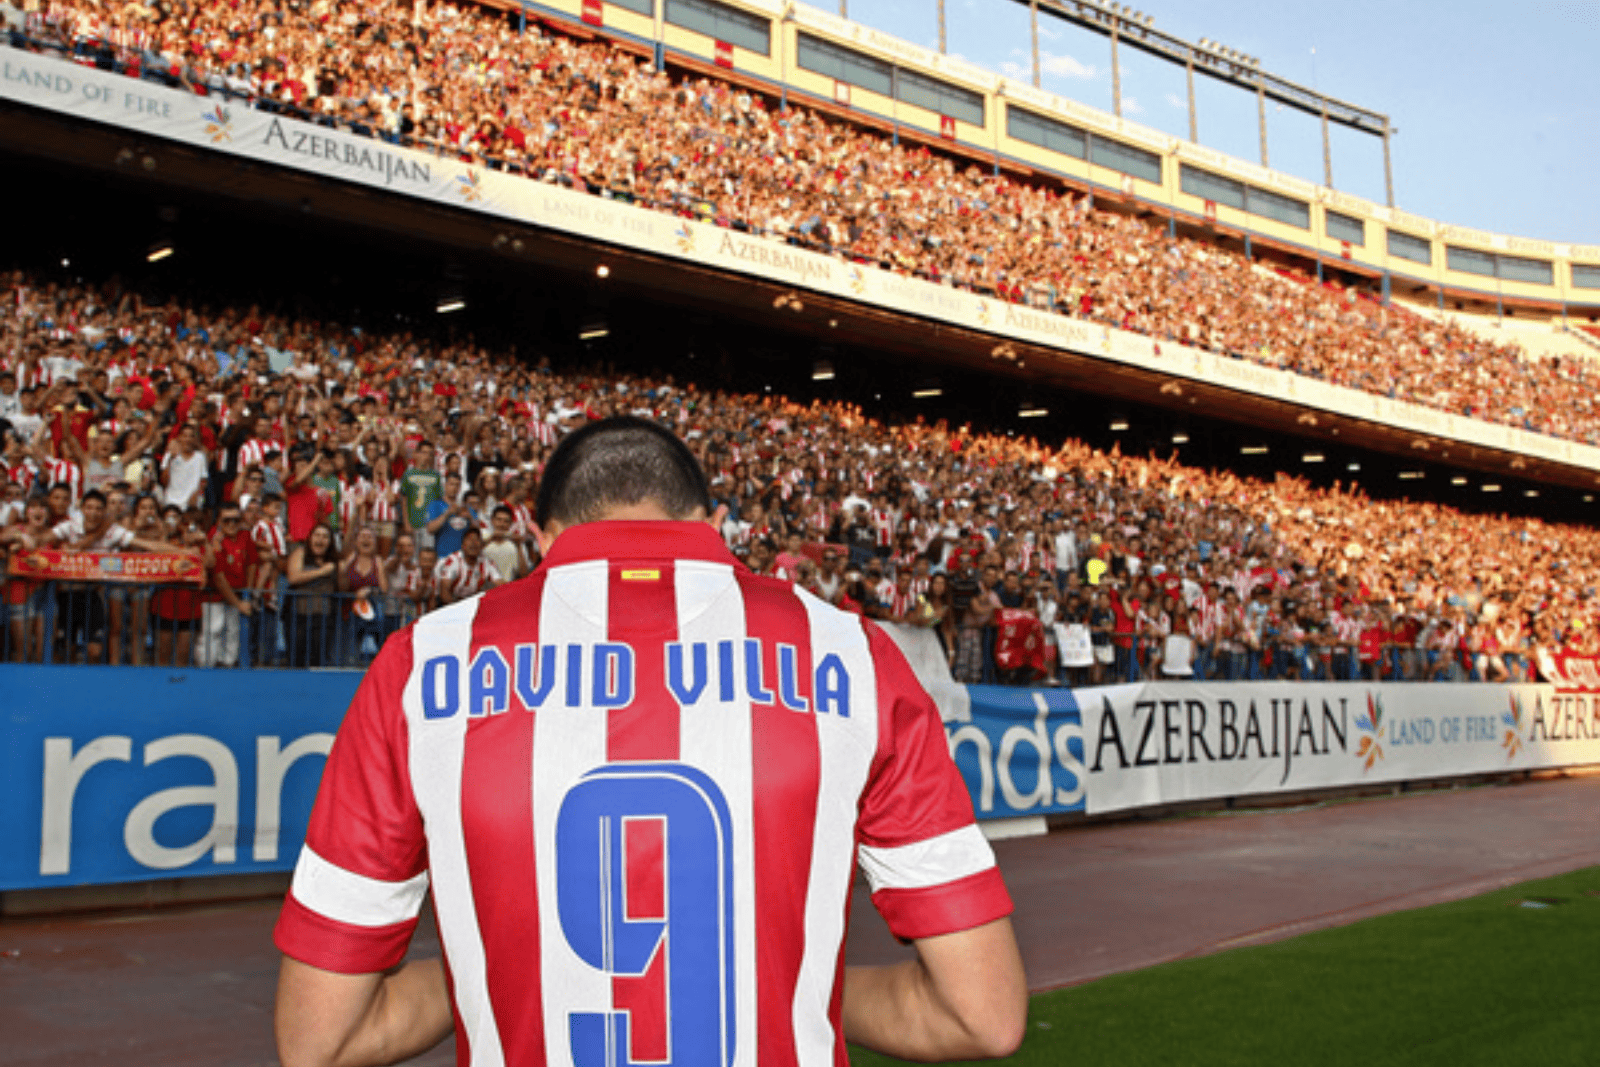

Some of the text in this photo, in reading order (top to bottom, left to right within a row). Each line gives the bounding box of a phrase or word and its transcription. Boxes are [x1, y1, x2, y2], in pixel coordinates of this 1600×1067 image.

[4, 62, 171, 118] LAND OF FIRE
[420, 637, 852, 720] DAVID VILLA
[1389, 716, 1497, 746] LAND OF FIRE
[555, 762, 738, 1067] 9
